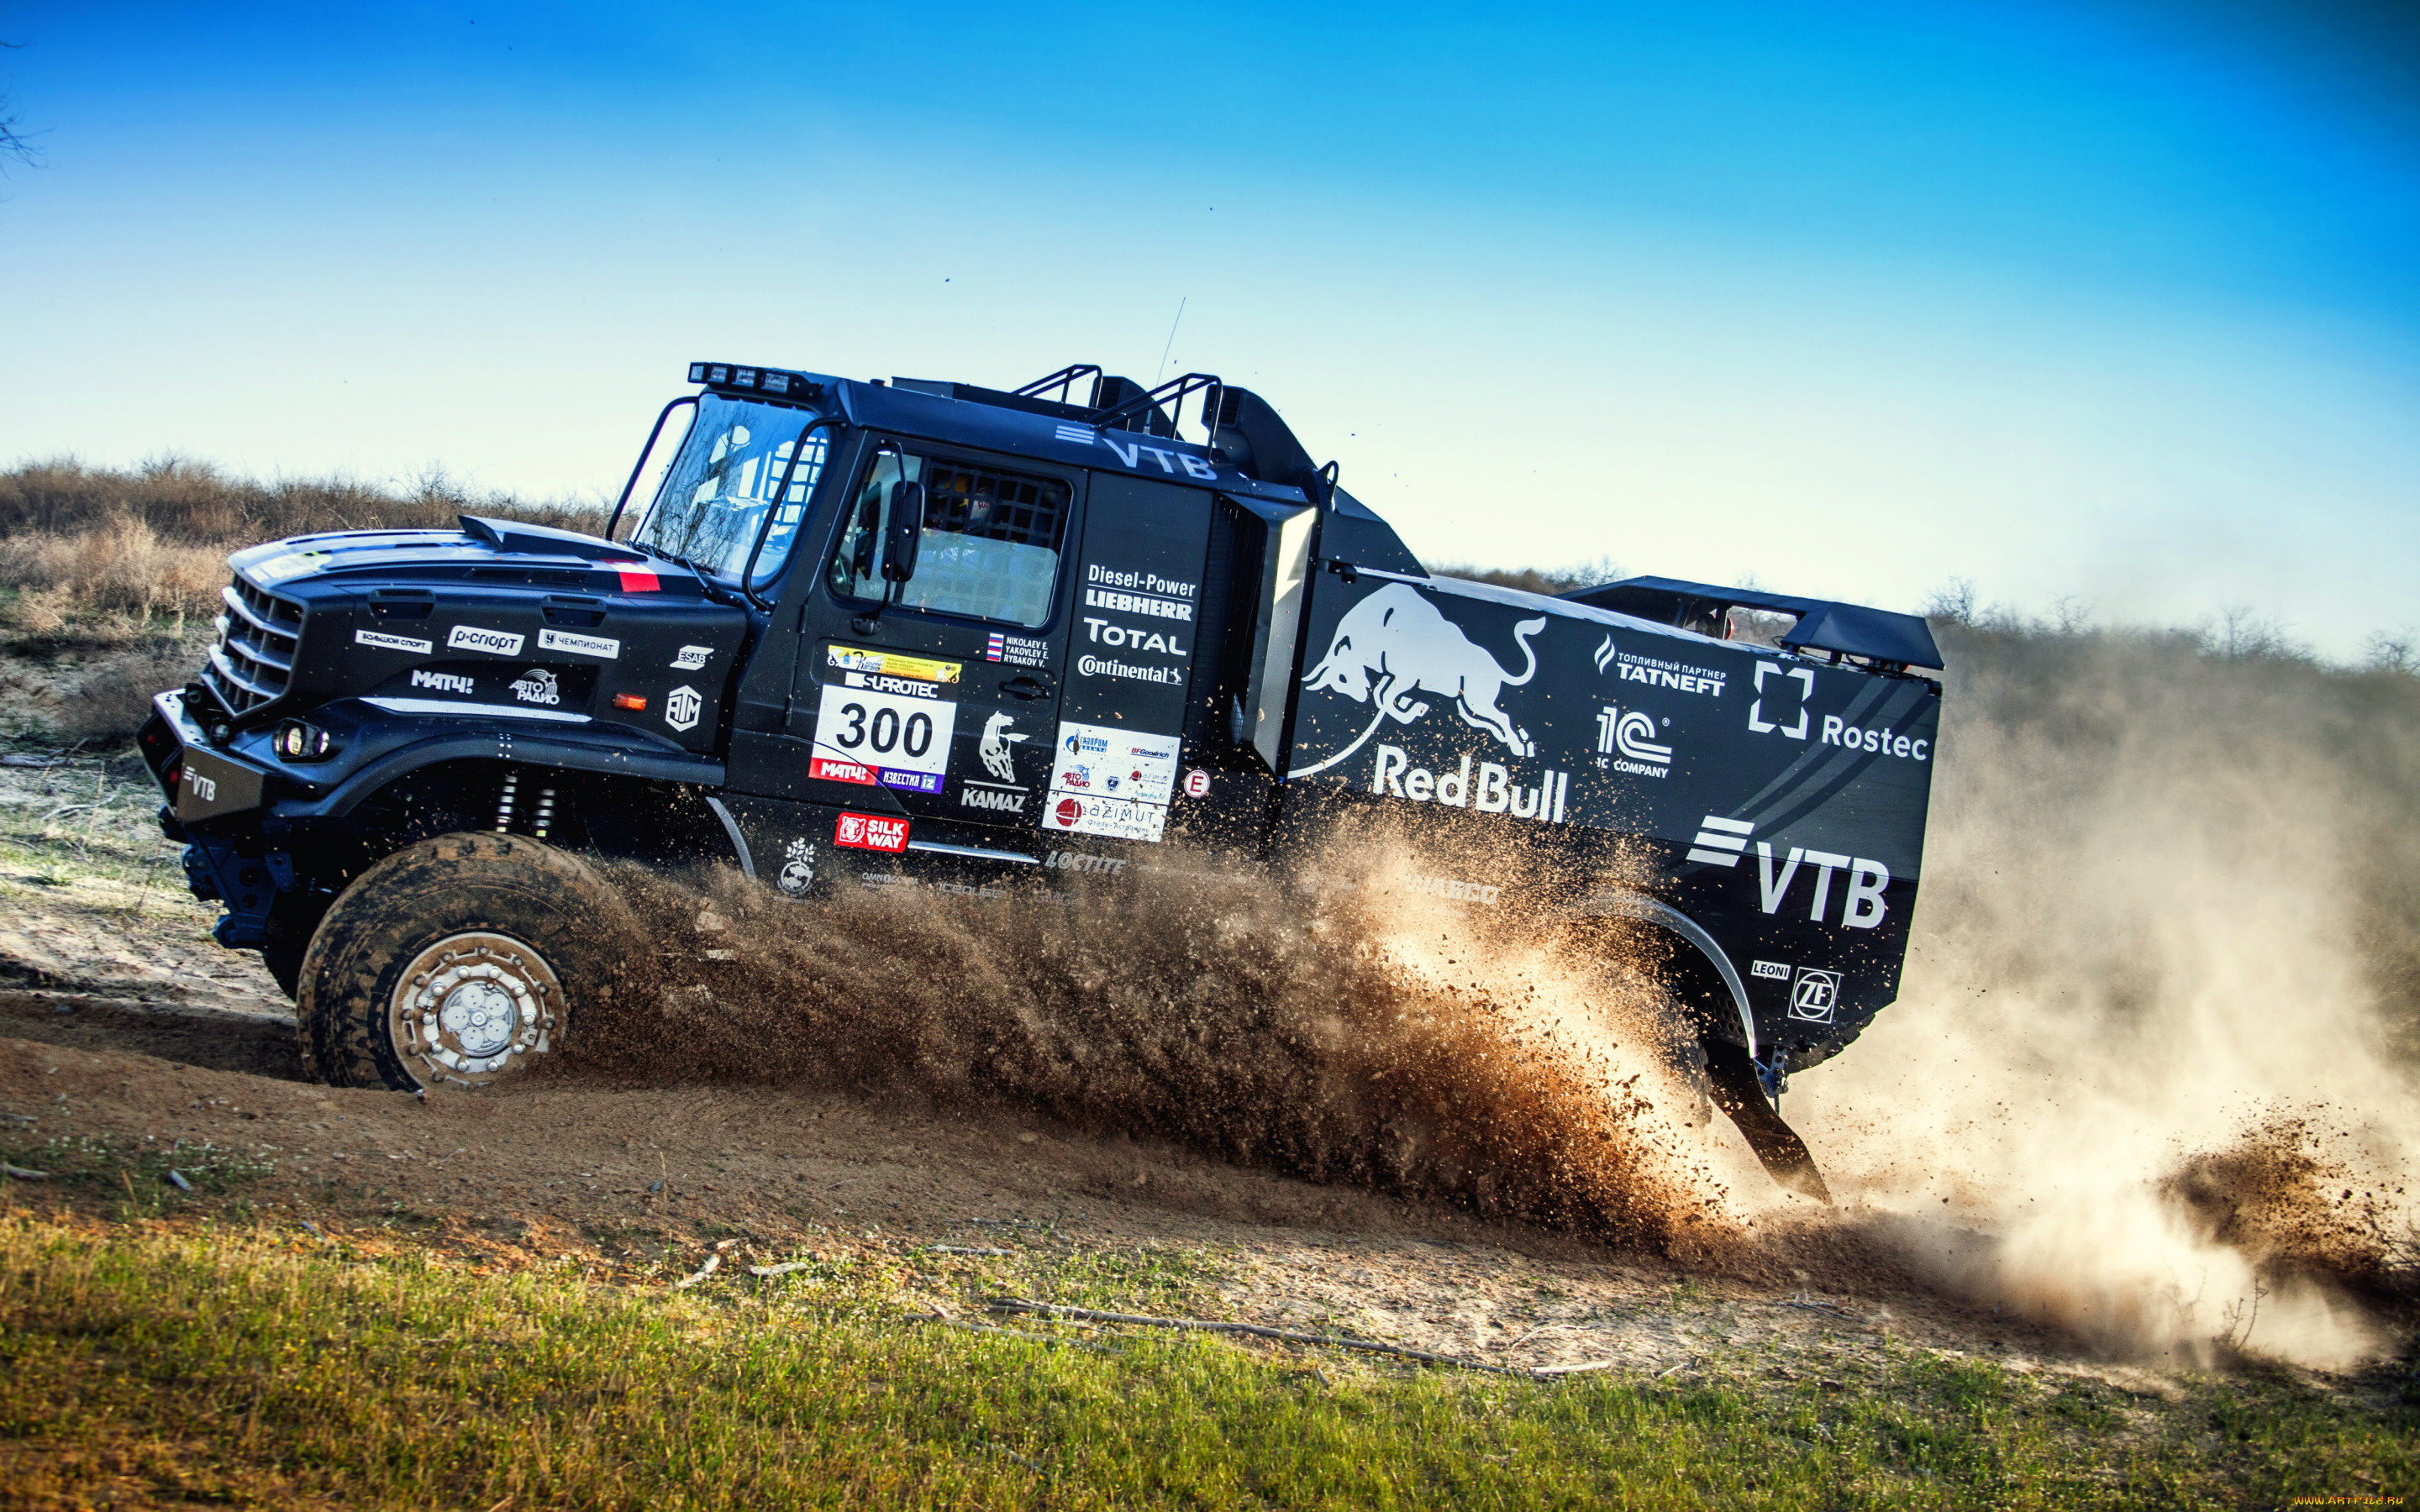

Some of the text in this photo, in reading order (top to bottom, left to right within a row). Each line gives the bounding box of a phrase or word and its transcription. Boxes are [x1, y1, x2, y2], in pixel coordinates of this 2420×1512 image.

[1102, 438, 1218, 480] VTB
[1088, 564, 1196, 597] Diesel-Power
[1086, 589, 1192, 622] LIEBHERR
[400, 640, 426, 648] СПОРТ
[558, 637, 613, 651] ЧЕМПИОНАТ
[1007, 637, 1049, 650] NIKOLAEV E.
[1083, 617, 1186, 656] TOTAL
[678, 652, 706, 664] ESAB
[1004, 654, 1044, 668] RYBAKOV V.
[1006, 645, 1049, 659] YAKOVLEV E.
[1077, 654, 1168, 684] Continental
[1618, 653, 1726, 680] ТОПЛИВНЫЙ ПАРТНЕР
[411, 669, 474, 695] МАТЧ!
[508, 680, 544, 692] АВТО
[862, 674, 939, 698] SUPROTEC
[1617, 662, 1725, 697] TATNEFT
[517, 690, 560, 705] РАДИО
[835, 702, 933, 758] 300
[1822, 714, 1928, 760] Rostec
[1080, 736, 1108, 748] ГАЗПРОМ
[1131, 748, 1170, 759] BFGoodrich
[820, 762, 867, 781] МАТЧ!
[883, 771, 919, 787] ИЗВЕСТИЯ
[1061, 772, 1081, 781] АВТО
[1597, 757, 1668, 779] 1C COMPANY
[193, 774, 216, 801] VTB
[1065, 780, 1090, 788] РАДИО
[1373, 743, 1568, 823] Red Bull
[961, 788, 1026, 813] KAMAZ
[867, 820, 905, 836] SILK
[866, 832, 902, 848] WAY
[1044, 850, 1126, 875] LOCTITE
[1756, 842, 1890, 929] VTB
[1753, 963, 1788, 978] LEONI
[1797, 979, 1833, 1011] ZF
